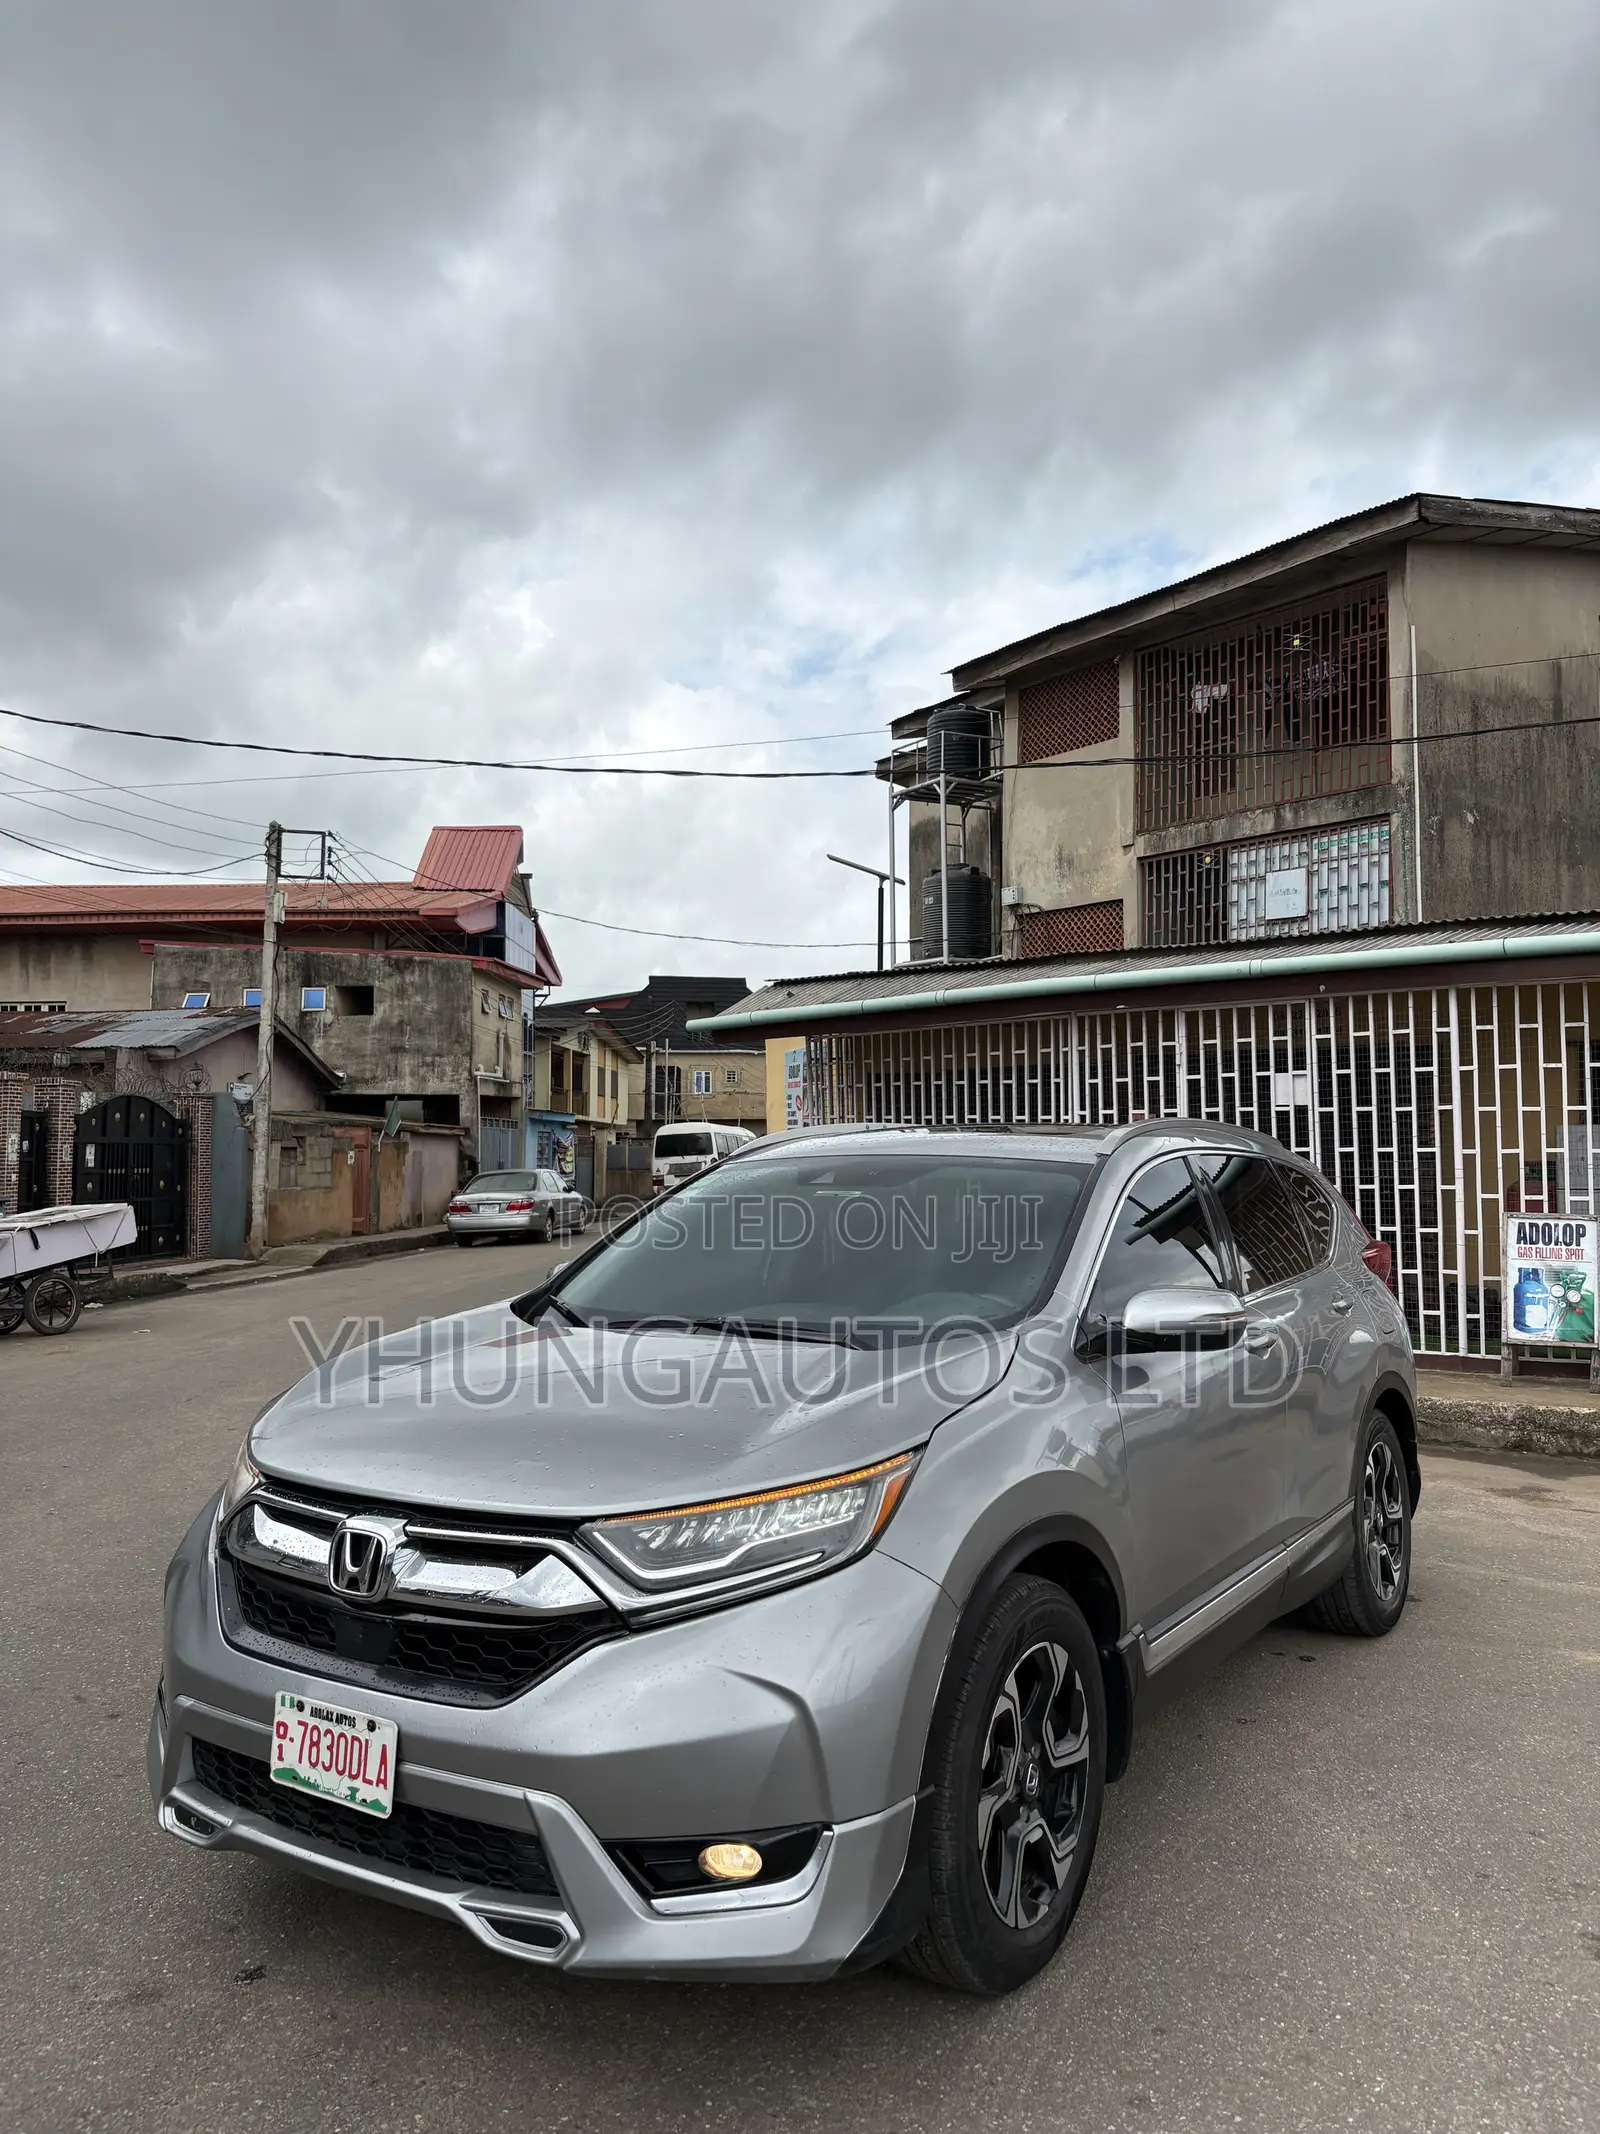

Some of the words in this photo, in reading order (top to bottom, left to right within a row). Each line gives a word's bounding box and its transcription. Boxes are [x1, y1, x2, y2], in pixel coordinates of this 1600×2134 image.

[1517, 1246, 1533, 1258] GAS
[1535, 1247, 1562, 1260] FILLING
[1565, 1248, 1585, 1260] SPOT
[335, 1712, 357, 1728] AUTOS
